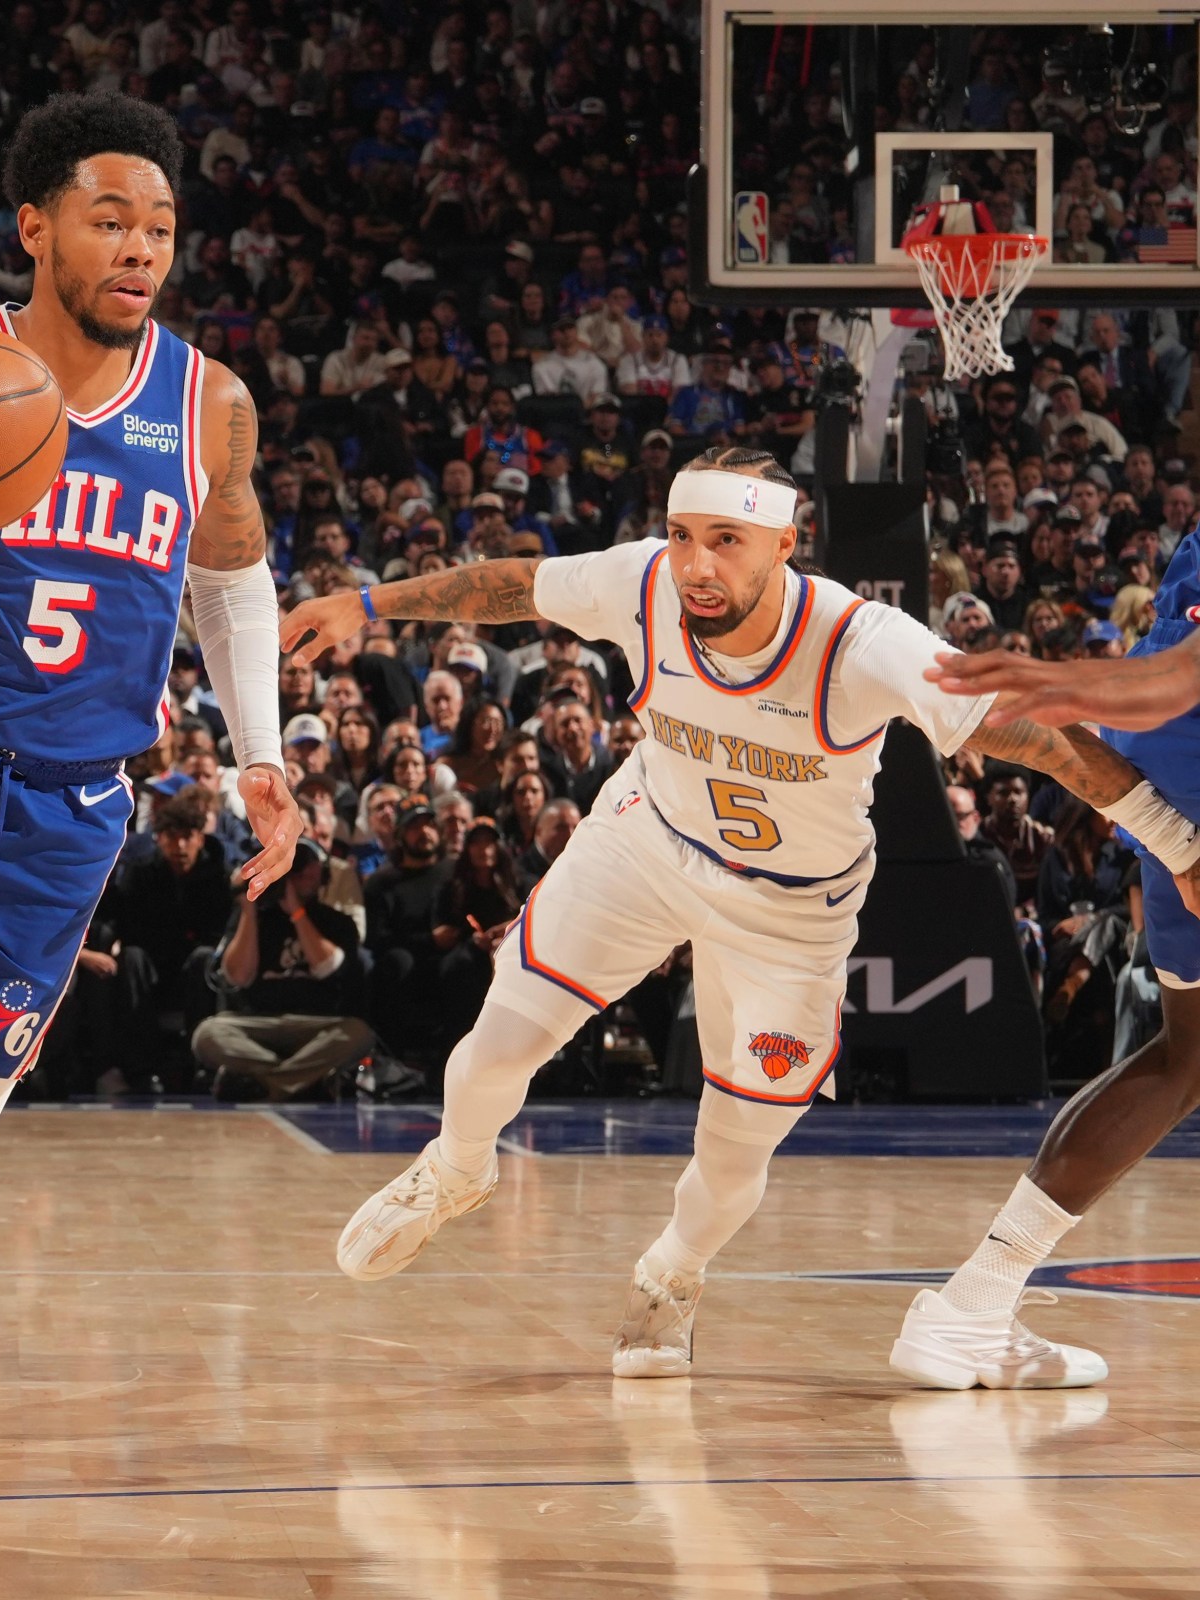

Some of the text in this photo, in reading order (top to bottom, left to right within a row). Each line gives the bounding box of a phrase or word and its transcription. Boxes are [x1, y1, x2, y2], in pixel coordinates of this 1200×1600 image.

[123, 414, 179, 438] Bloom
[123, 432, 179, 454] energy
[22, 578, 97, 675] 5
[778, 707, 809, 719] dhabi
[648, 707, 829, 783] NEW YORK
[705, 778, 783, 852] 5
[747, 1032, 810, 1064] KNICKS
